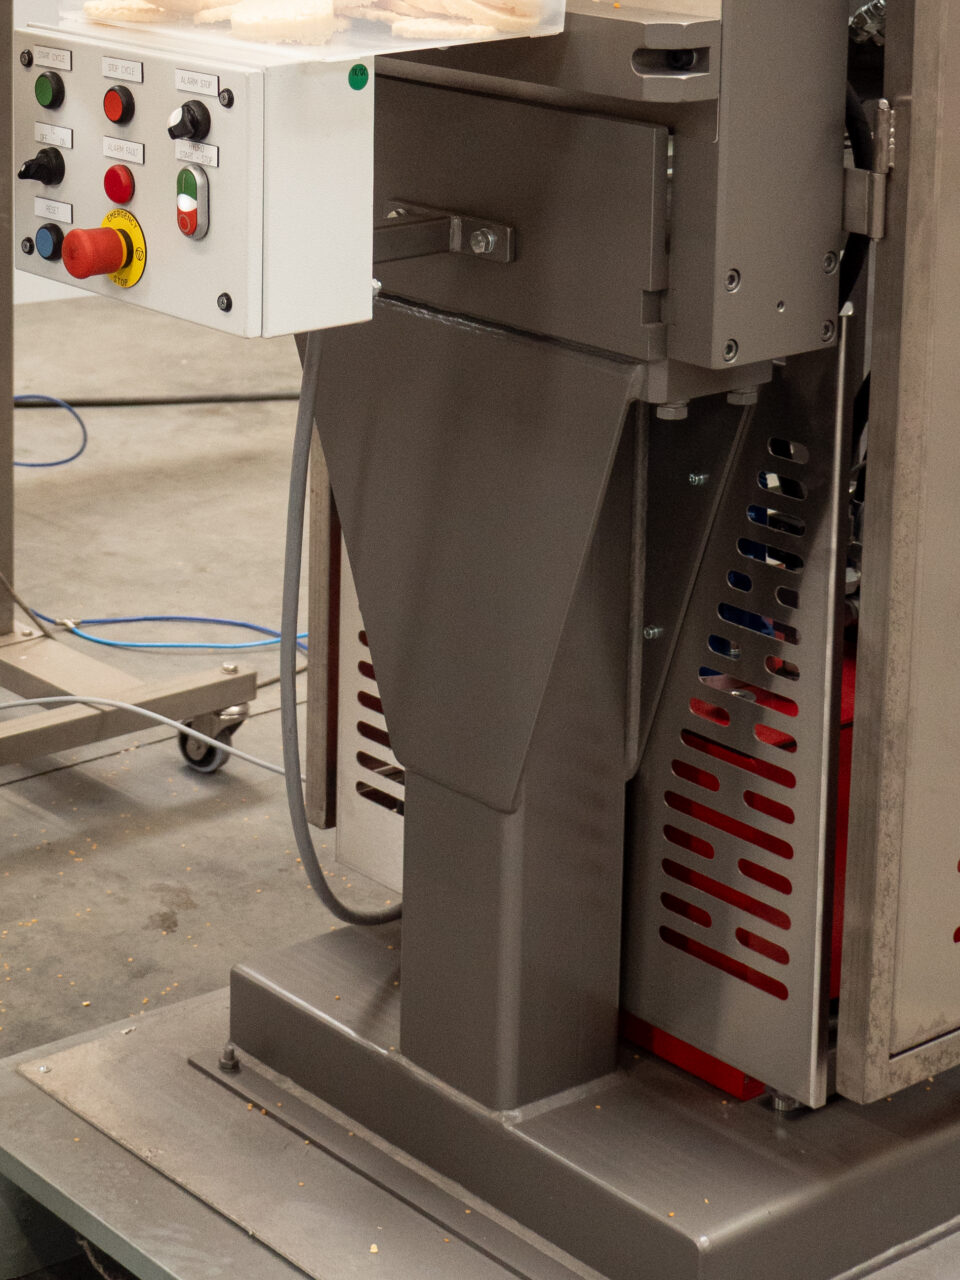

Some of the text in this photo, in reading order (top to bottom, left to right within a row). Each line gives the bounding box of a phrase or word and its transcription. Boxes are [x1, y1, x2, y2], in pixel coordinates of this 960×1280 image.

[108, 63, 119, 73] STOP
[180, 76, 213, 89] ALARM STOP
[107, 210, 137, 229] EMERGENCY
[113, 275, 128, 286] STOP
